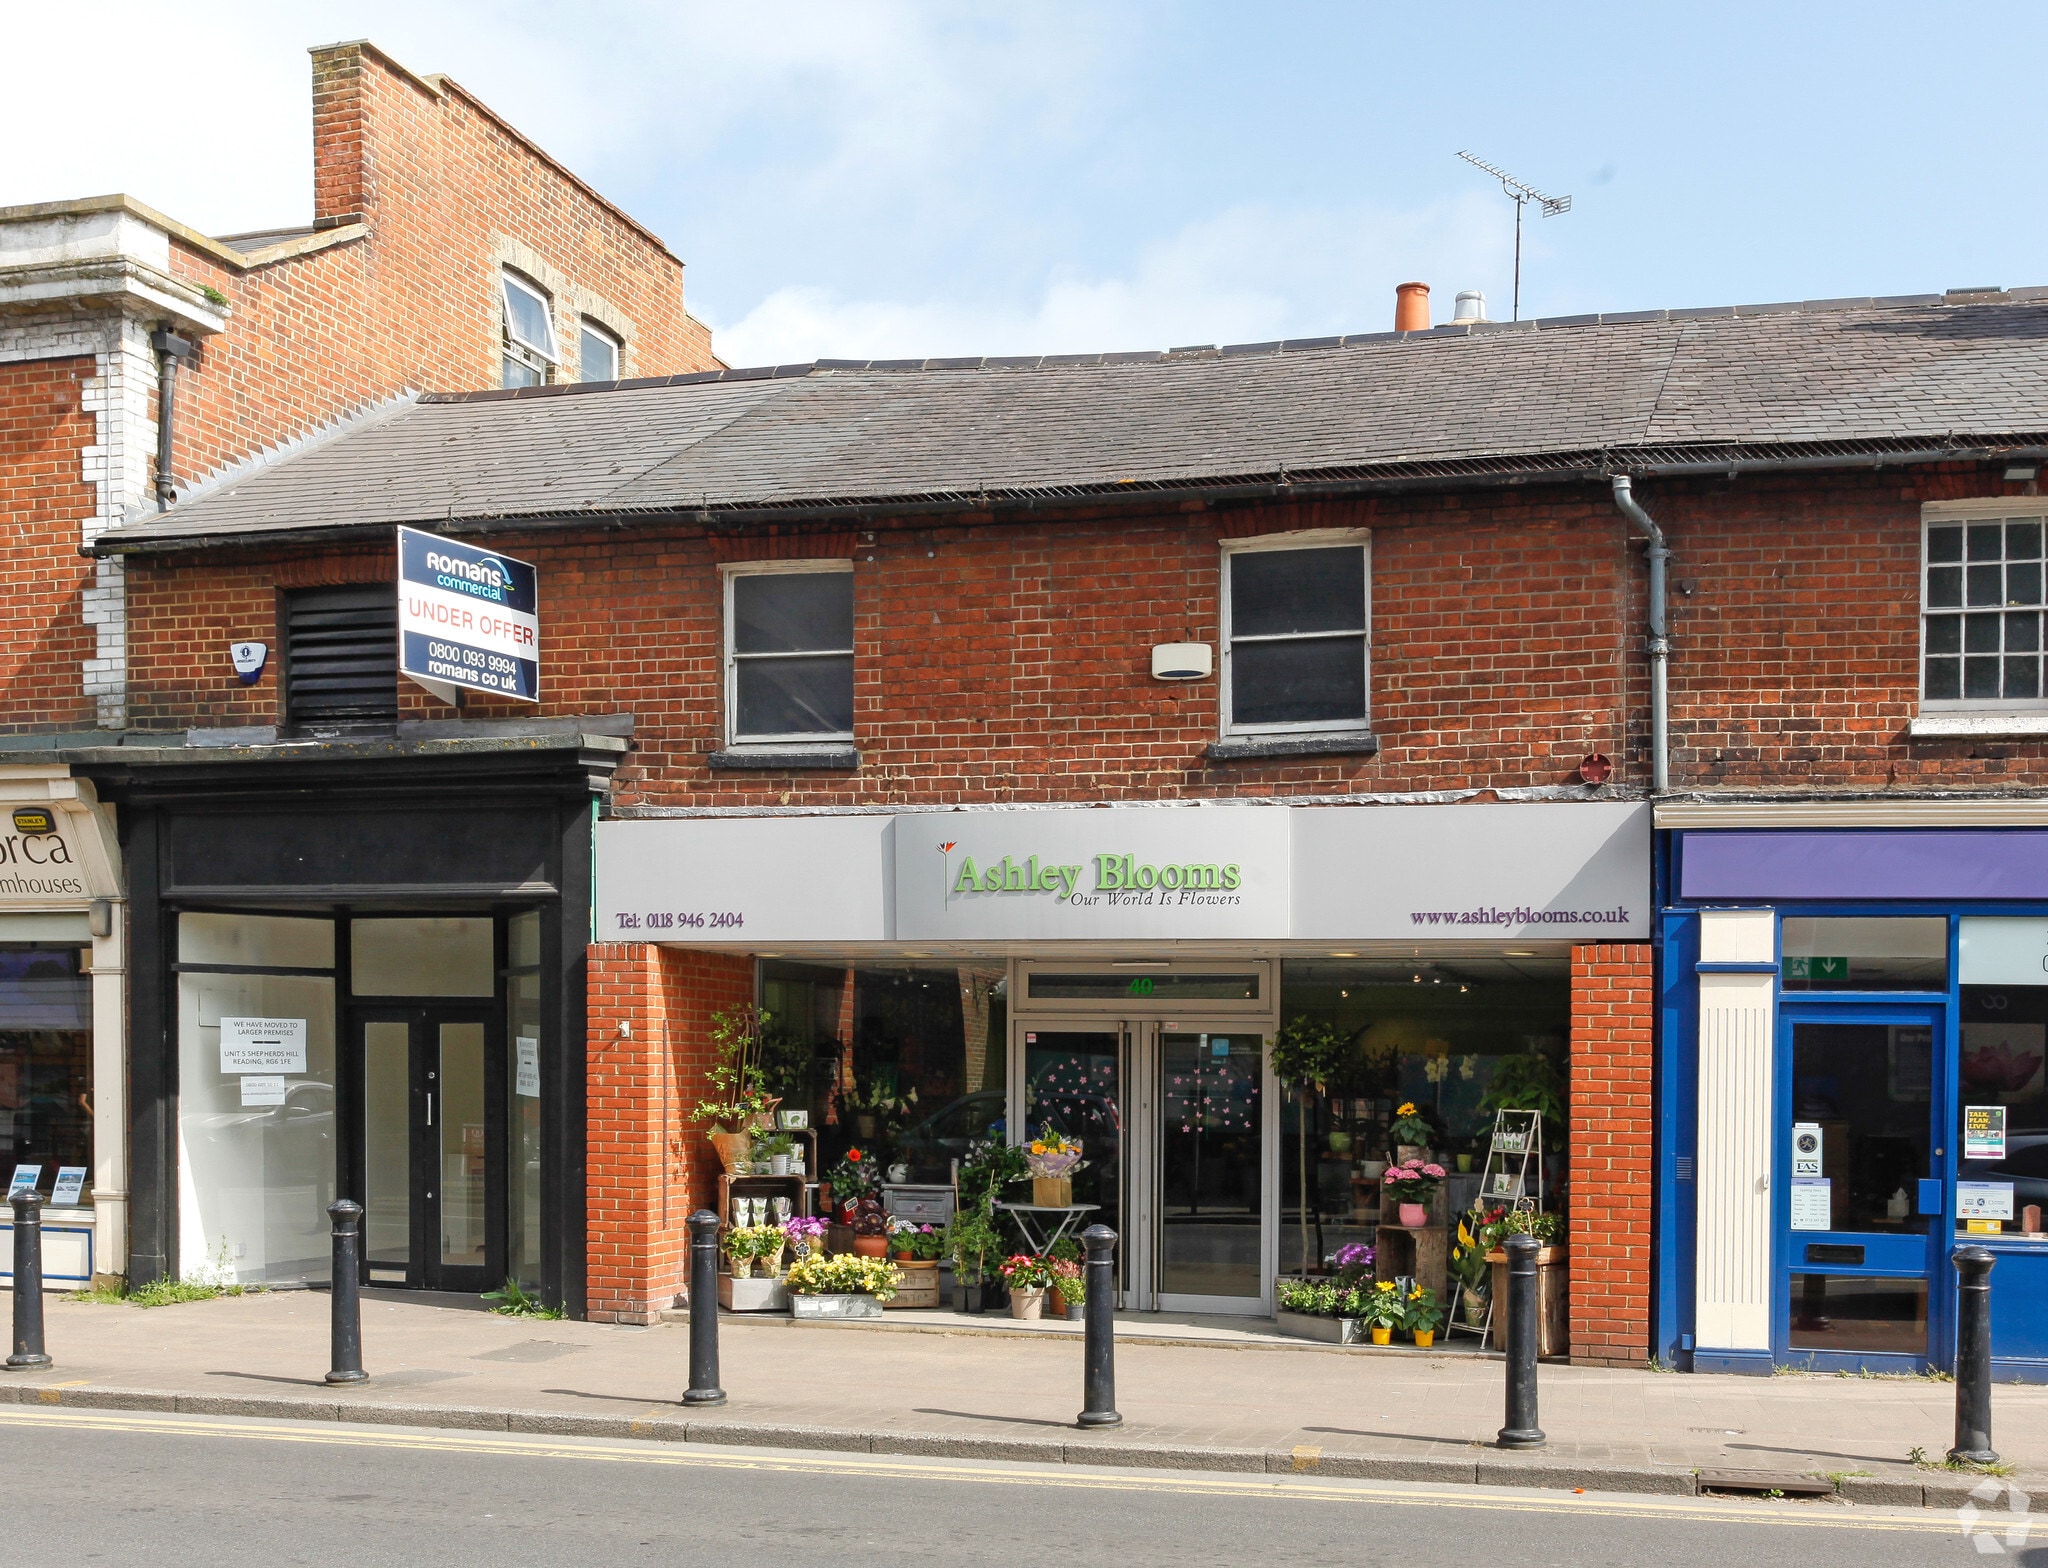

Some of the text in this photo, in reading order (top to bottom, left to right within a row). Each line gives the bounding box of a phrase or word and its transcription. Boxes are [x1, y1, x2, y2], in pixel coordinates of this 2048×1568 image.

[437, 574, 501, 601] commercial
[409, 597, 534, 646] UNDER OFFER
[429, 641, 517, 675] 0800 093 9994
[0, 834, 74, 865] rca
[954, 853, 1242, 900] Ashley Blooms
[1070, 891, 1241, 906] Our World Is Flowers
[615, 911, 744, 928] Tel: 0118 946 2404
[1410, 906, 1630, 929] www.ashleyblooms.co.uk
[1128, 978, 1153, 995] 40
[233, 1058, 264, 1066] READING,
